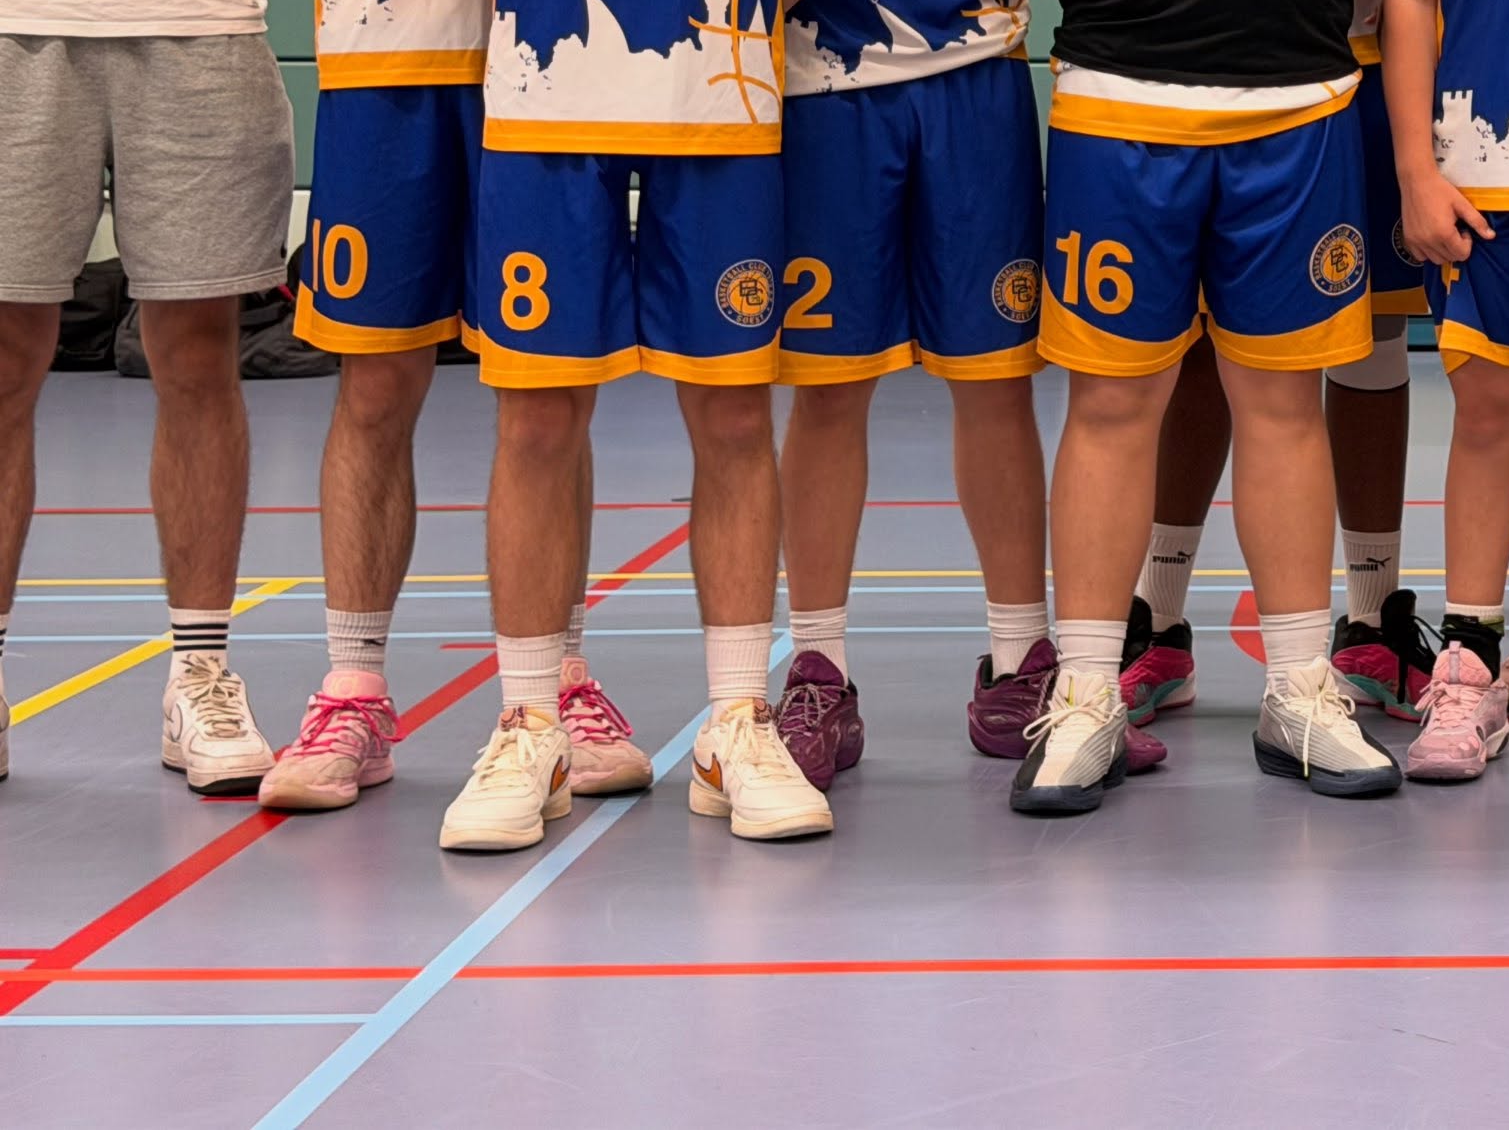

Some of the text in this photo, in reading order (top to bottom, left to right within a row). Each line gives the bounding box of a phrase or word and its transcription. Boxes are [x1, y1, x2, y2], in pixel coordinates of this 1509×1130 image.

[501, 251, 549, 331] 8
[783, 257, 832, 329] 2
[1055, 230, 1134, 314] 16
